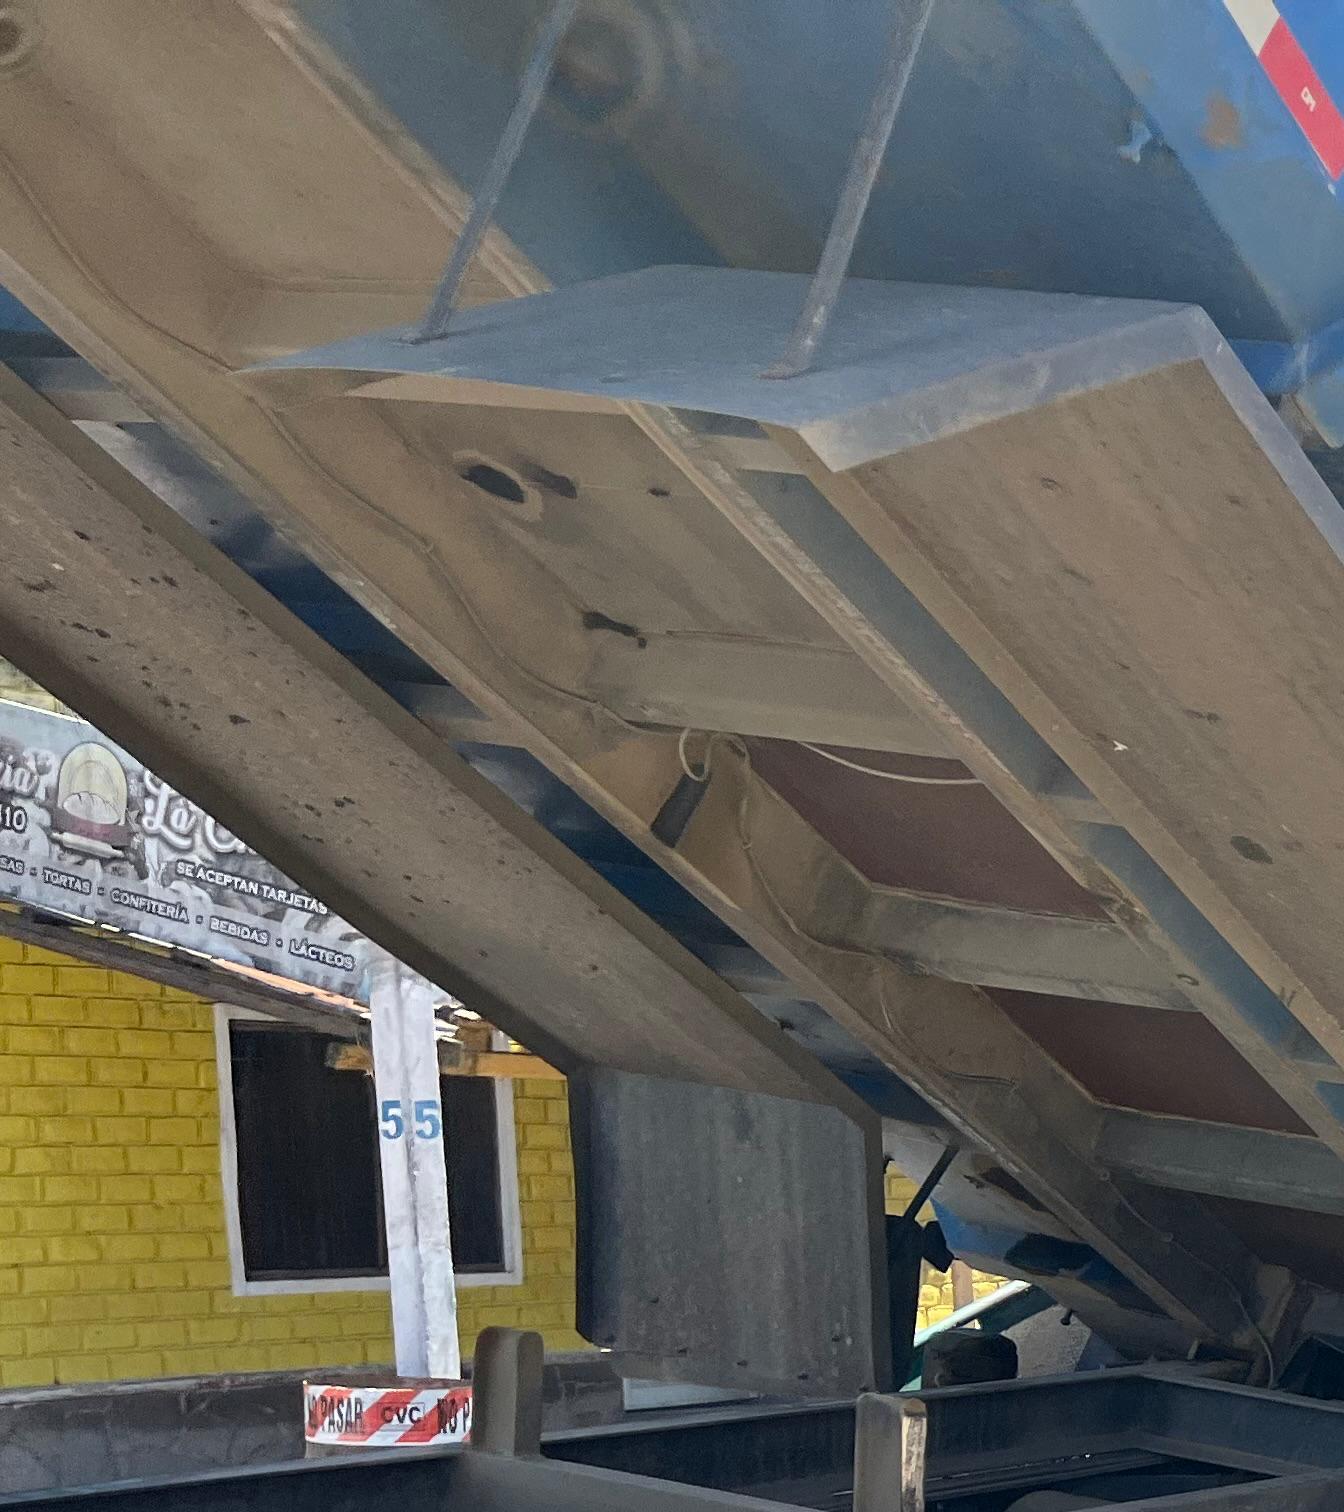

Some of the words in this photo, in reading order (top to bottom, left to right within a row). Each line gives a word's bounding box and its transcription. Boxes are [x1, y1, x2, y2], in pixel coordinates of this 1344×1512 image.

[177, 860, 195, 877] SE
[197, 868, 259, 894] ACEPTAN
[262, 886, 328, 915] TARJETAS
[43, 869, 91, 894] TORTAS
[110, 889, 189, 923] CONFITERÍA
[210, 917, 269, 945] BEBIDAS
[291, 938, 355, 970] LÁCTEOS
[320, 1394, 363, 1434] PASAR
[382, 1406, 421, 1424] CVC
[437, 1398, 458, 1434] NO
